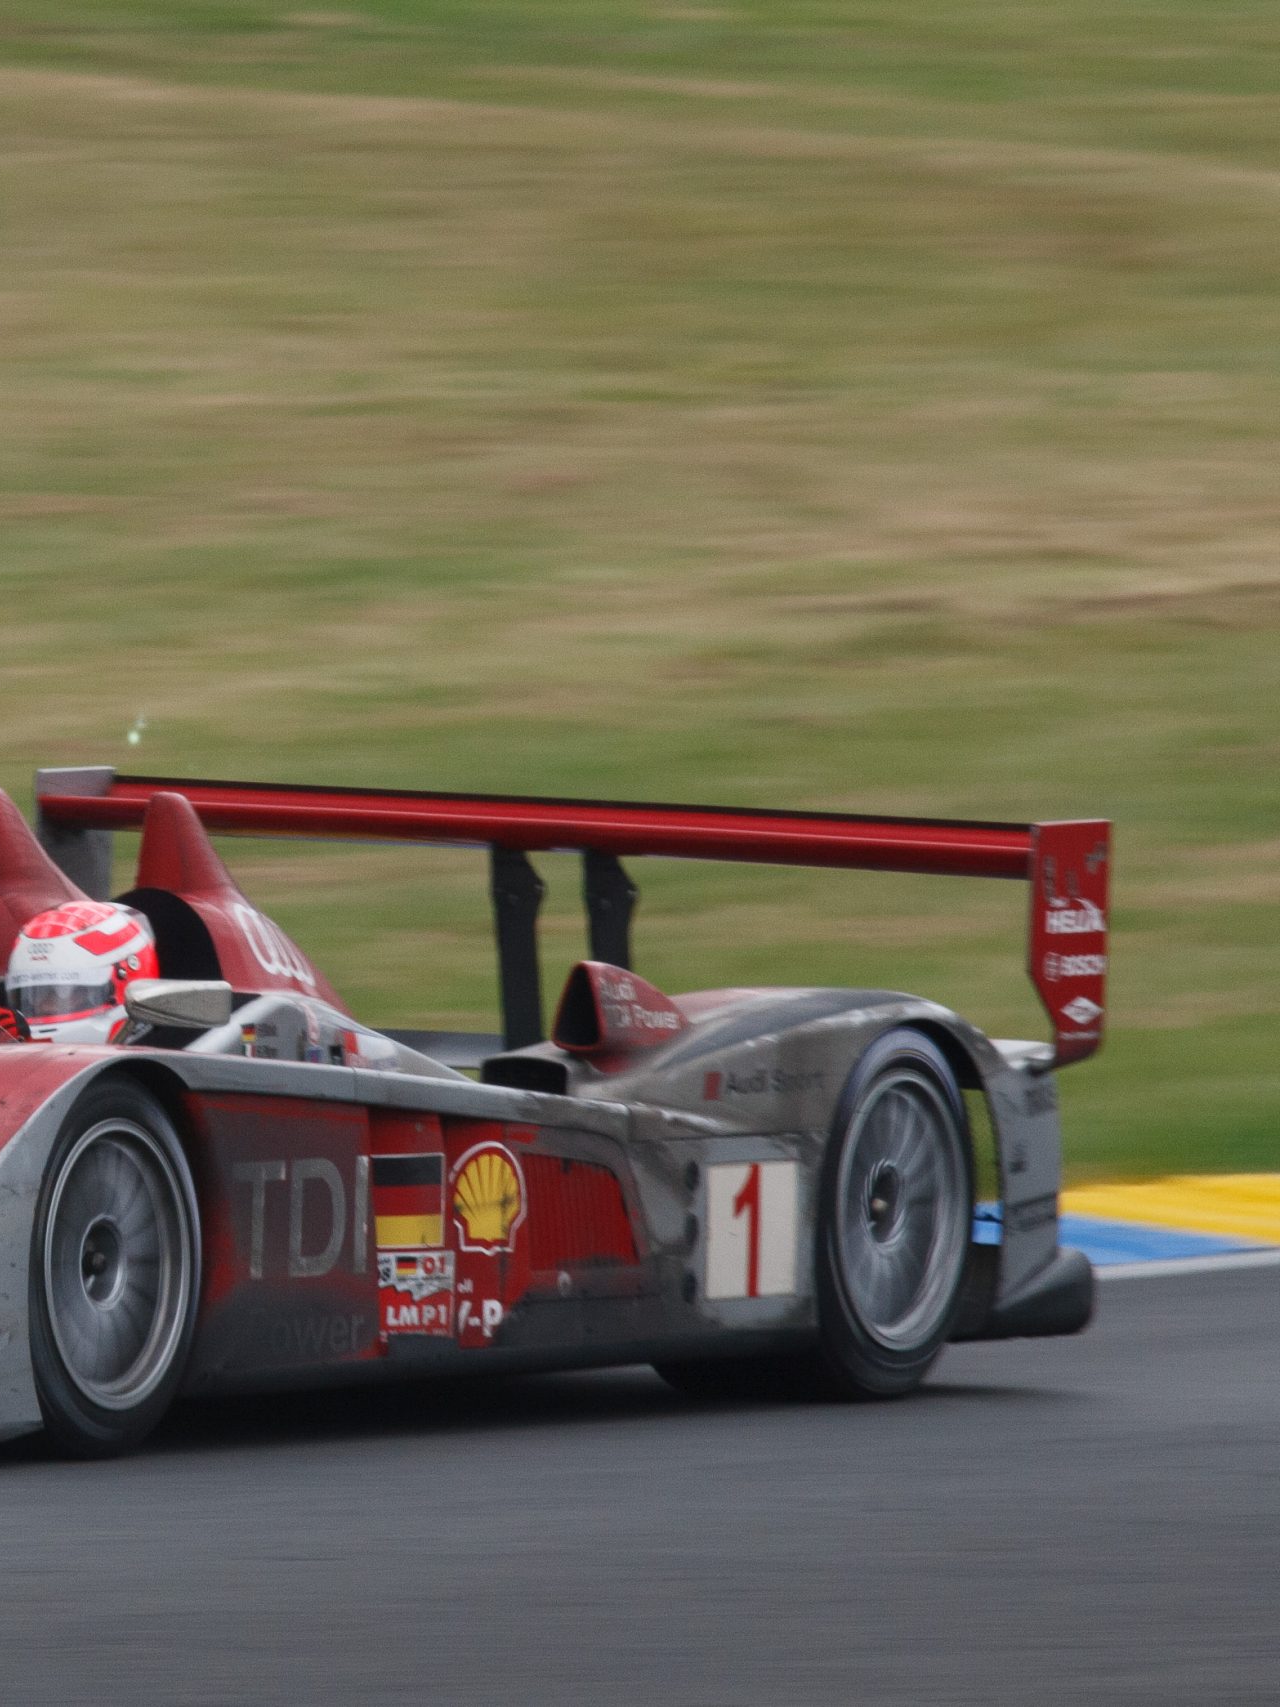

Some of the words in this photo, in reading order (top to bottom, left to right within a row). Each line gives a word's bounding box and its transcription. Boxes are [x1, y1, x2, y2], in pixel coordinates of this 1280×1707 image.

[231, 1154, 369, 1280] TDI
[732, 1161, 761, 1298] 1
[386, 1304, 447, 1327] LMP1
